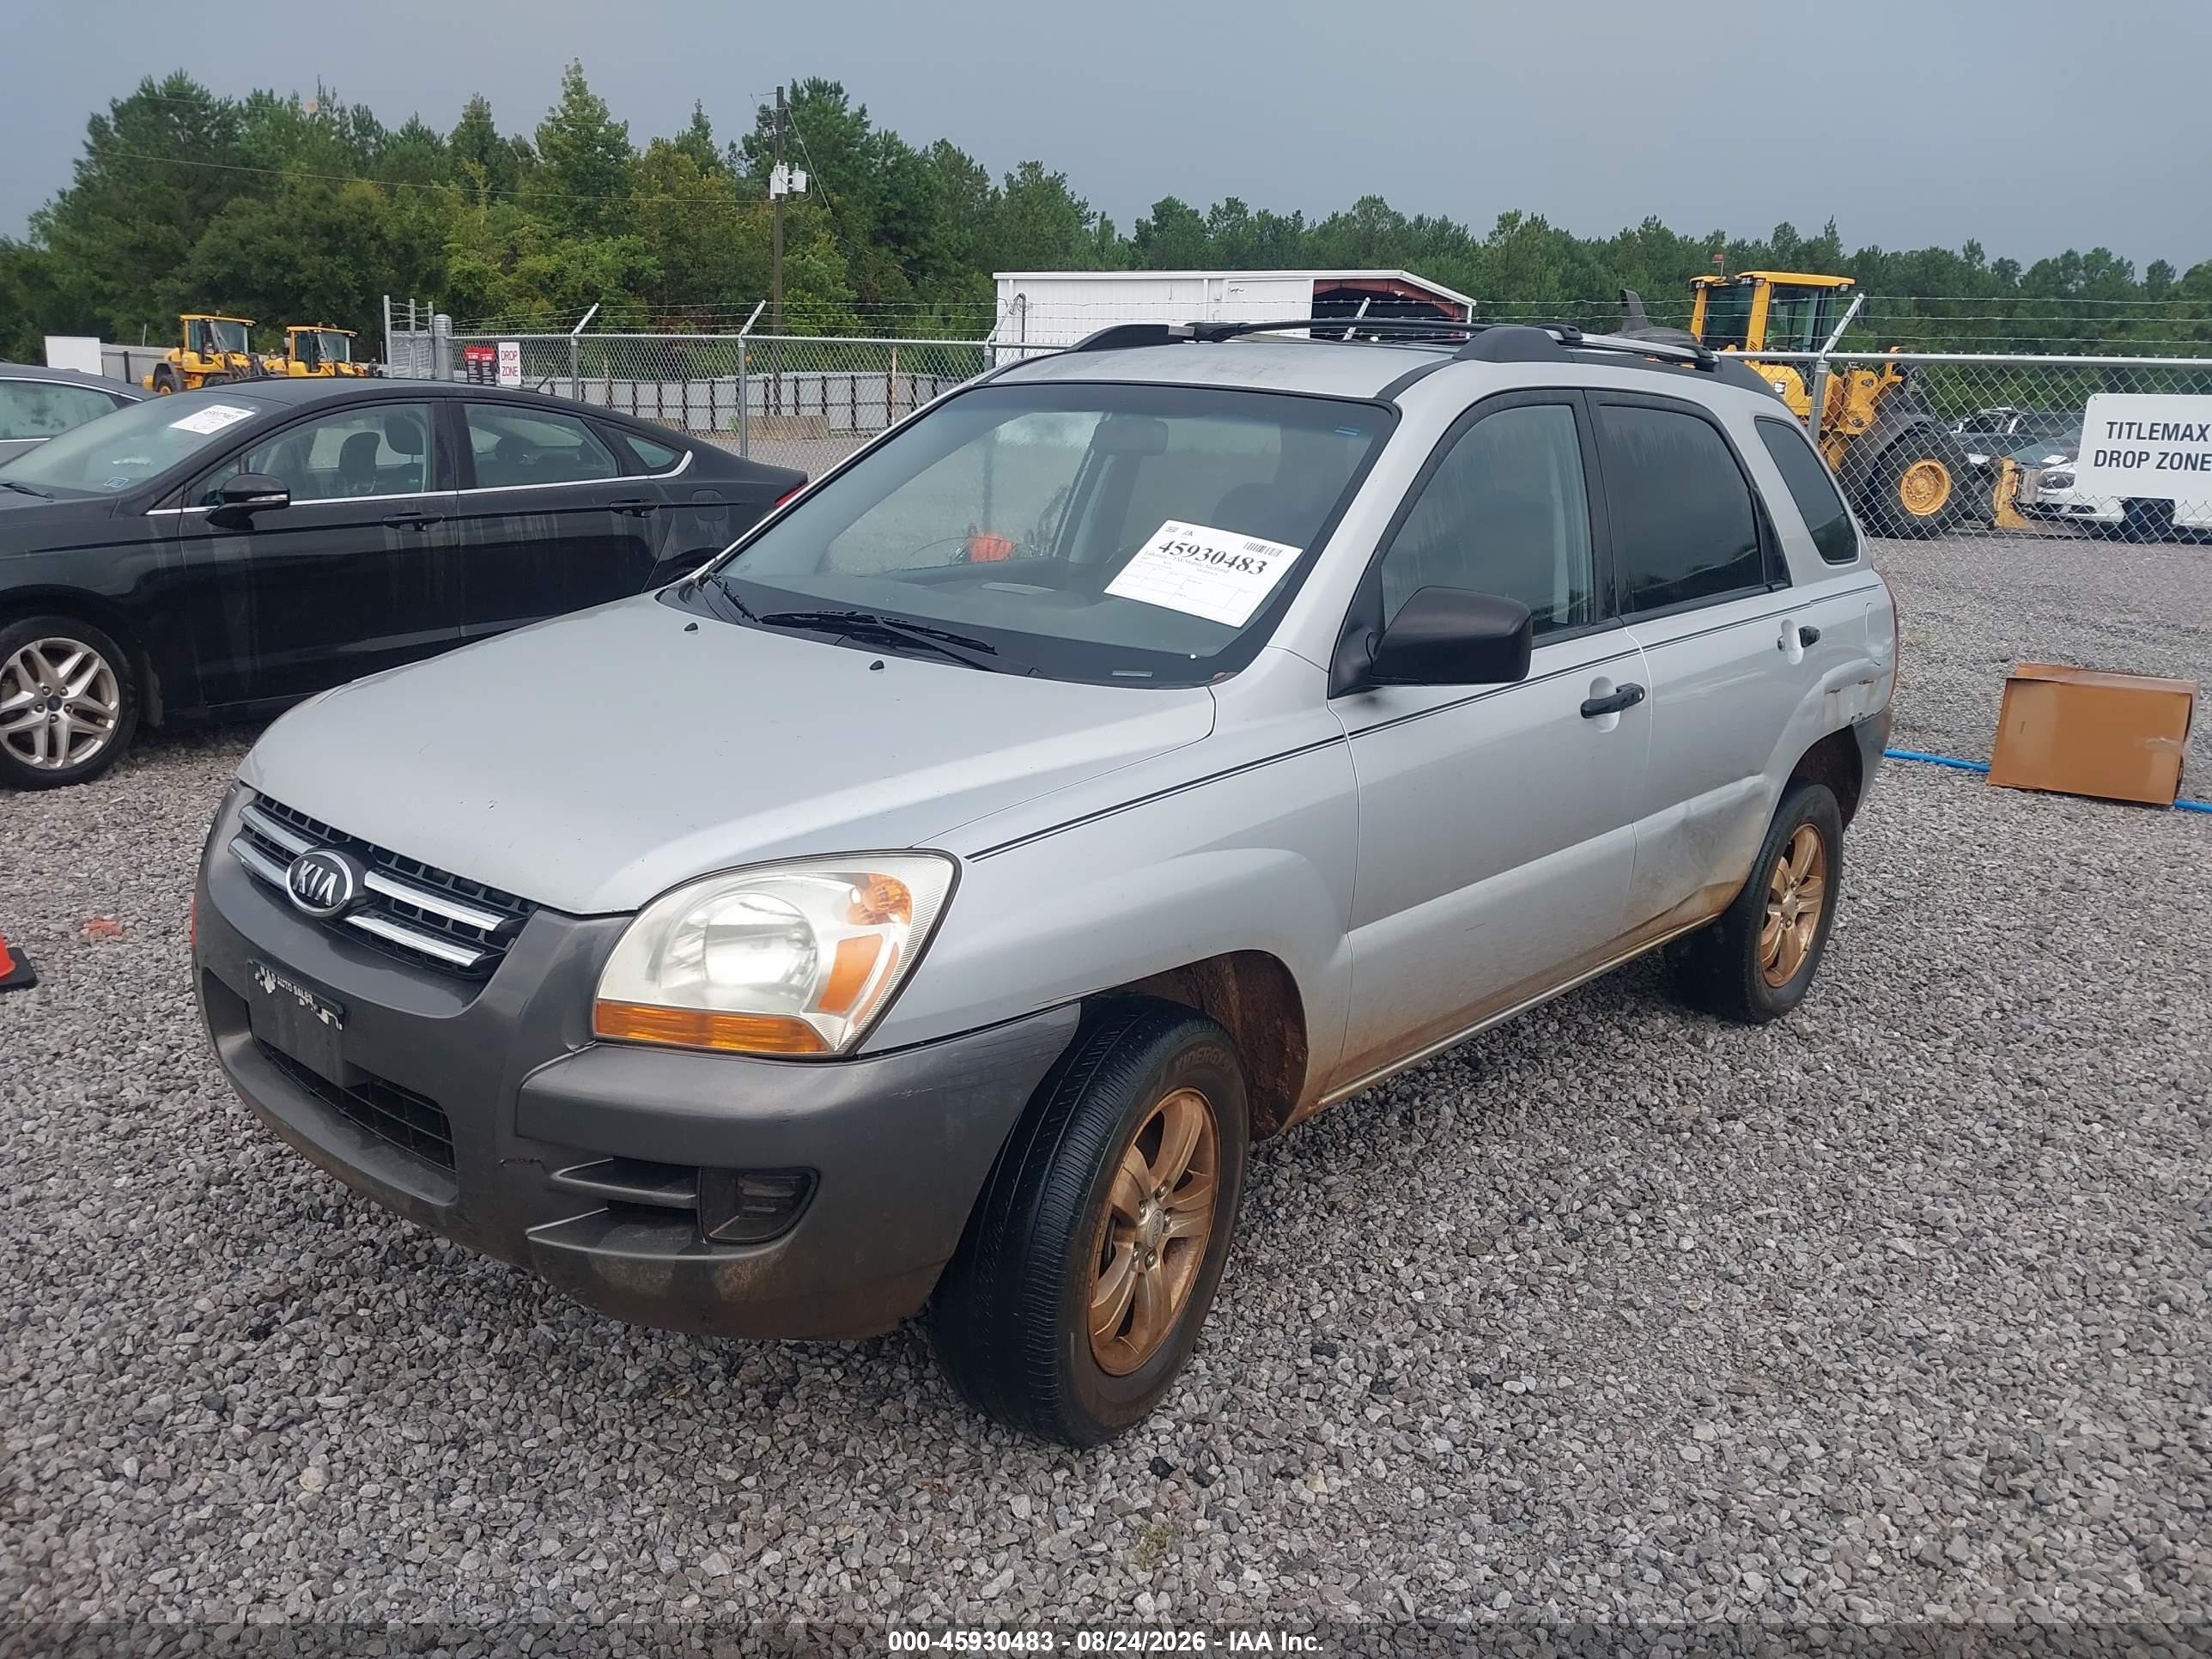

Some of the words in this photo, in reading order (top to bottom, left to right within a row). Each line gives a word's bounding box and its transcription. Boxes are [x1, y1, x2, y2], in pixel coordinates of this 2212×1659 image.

[501, 350, 518, 361] DROP
[501, 366, 519, 377] ZONE
[2106, 421, 2210, 442] TITLEMAX
[2093, 449, 2150, 469] DROP
[2155, 452, 2212, 471] ZONE
[1158, 539, 1267, 575] 45930483
[293, 859, 338, 907] KIA
